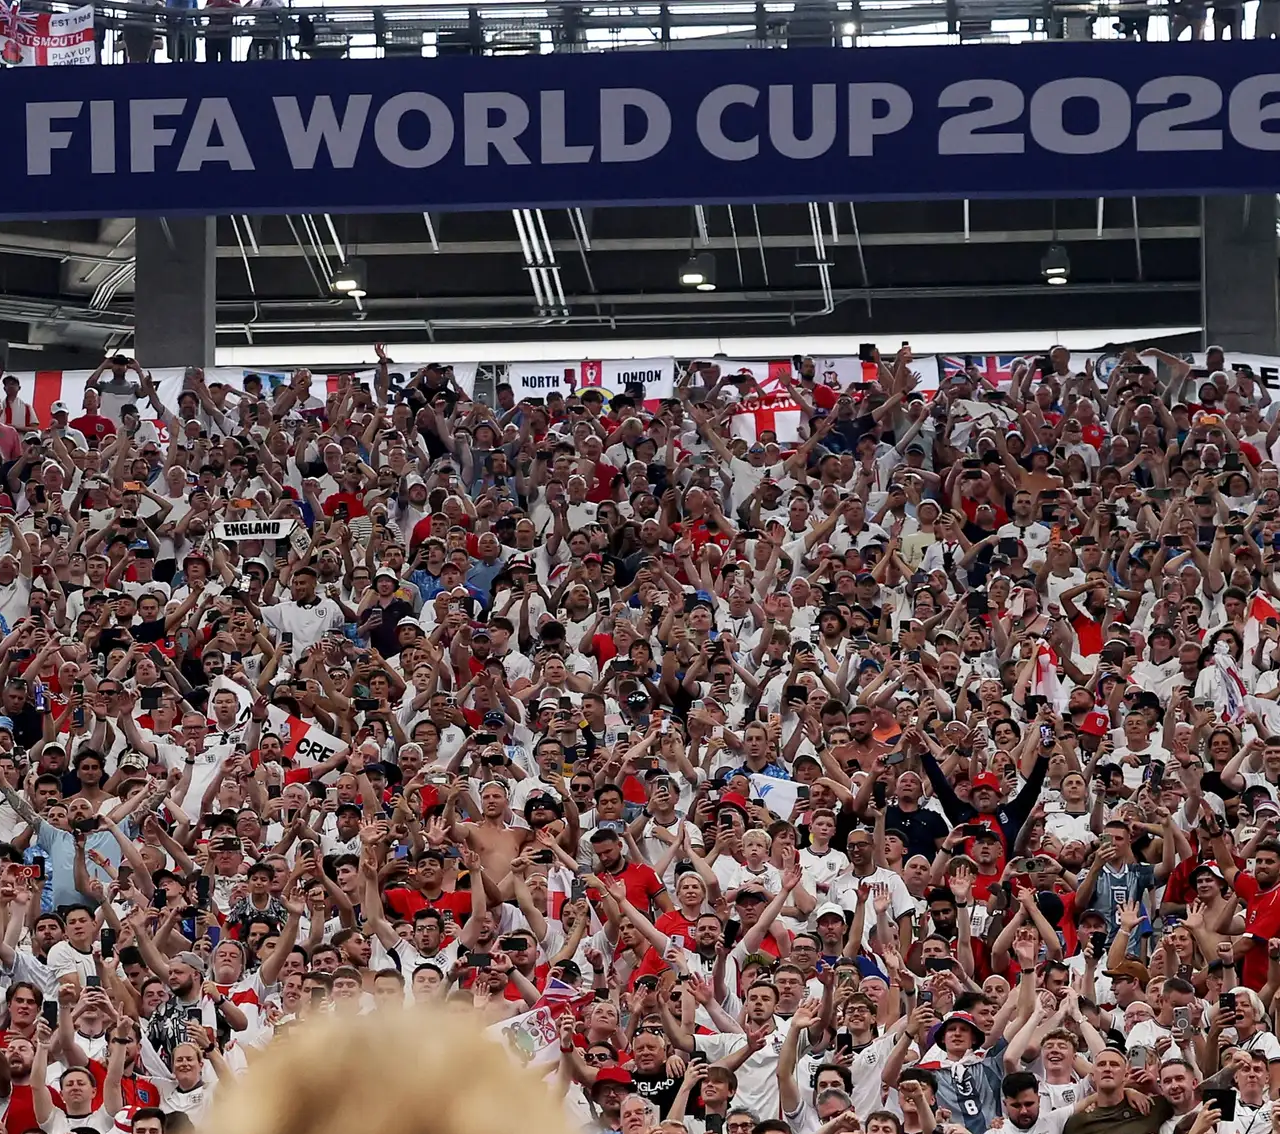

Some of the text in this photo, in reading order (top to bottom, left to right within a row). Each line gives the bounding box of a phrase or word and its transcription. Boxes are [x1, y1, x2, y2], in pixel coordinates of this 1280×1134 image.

[51, 20, 70, 28] EST
[3, 25, 84, 47] PORTSMOUTH
[52, 47, 91, 60] PLAY UP
[24, 96, 257, 177] FIFA
[272, 86, 672, 171] WORLD
[696, 81, 914, 162] CUP
[521, 369, 662, 388] NORTH LONDON
[223, 522, 281, 537] ENGLAND
[963, 1099, 979, 1116] 8
